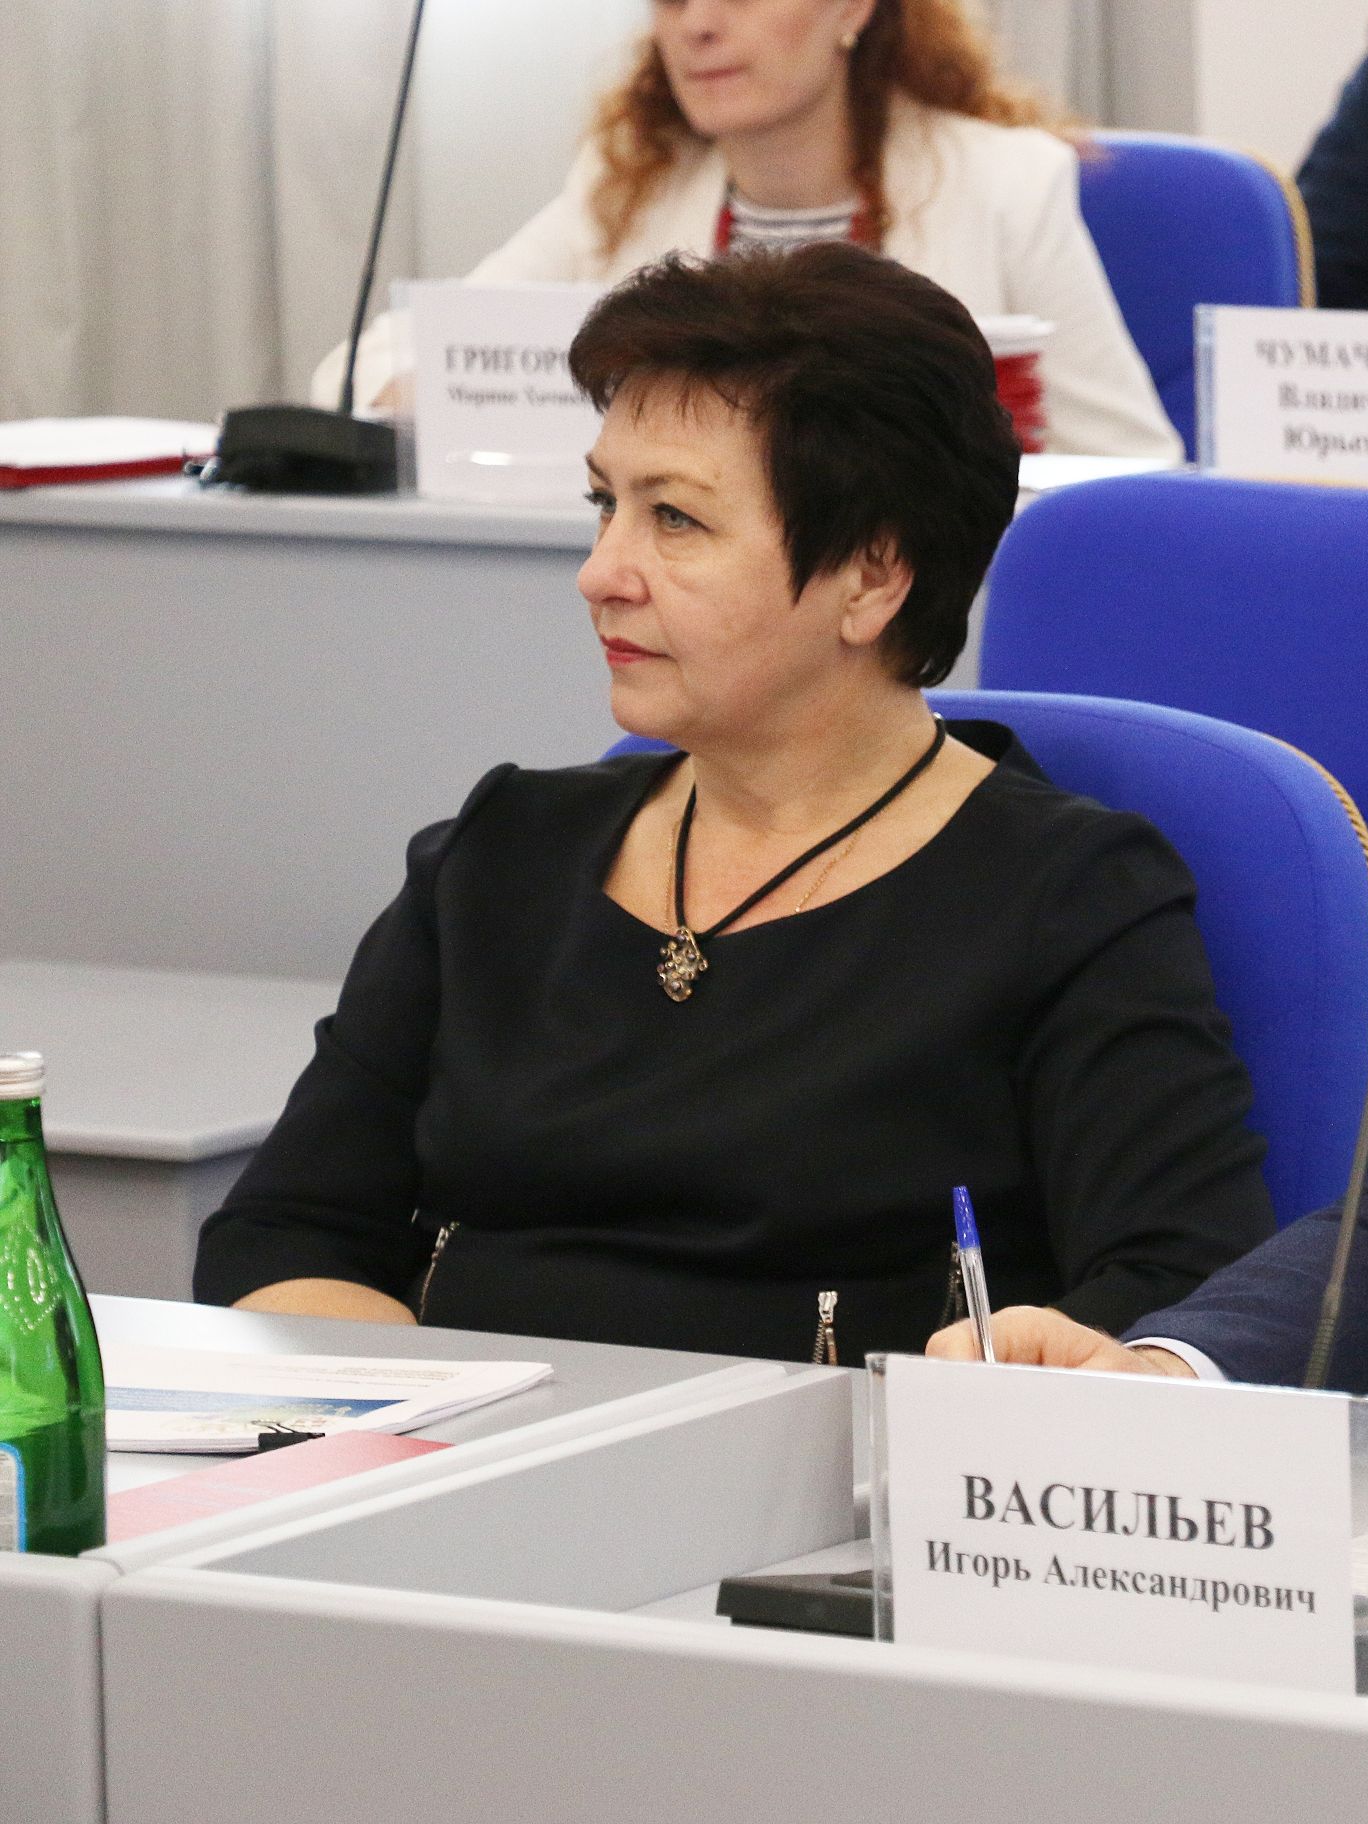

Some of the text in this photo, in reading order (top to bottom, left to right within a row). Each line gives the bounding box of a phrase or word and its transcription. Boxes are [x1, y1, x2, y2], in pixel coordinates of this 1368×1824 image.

[446, 345, 569, 374] ГРИГОР
[961, 1474, 1274, 1551] ВАСИЛЬЕВ
[925, 1539, 1317, 1615] Игорь Александрович
